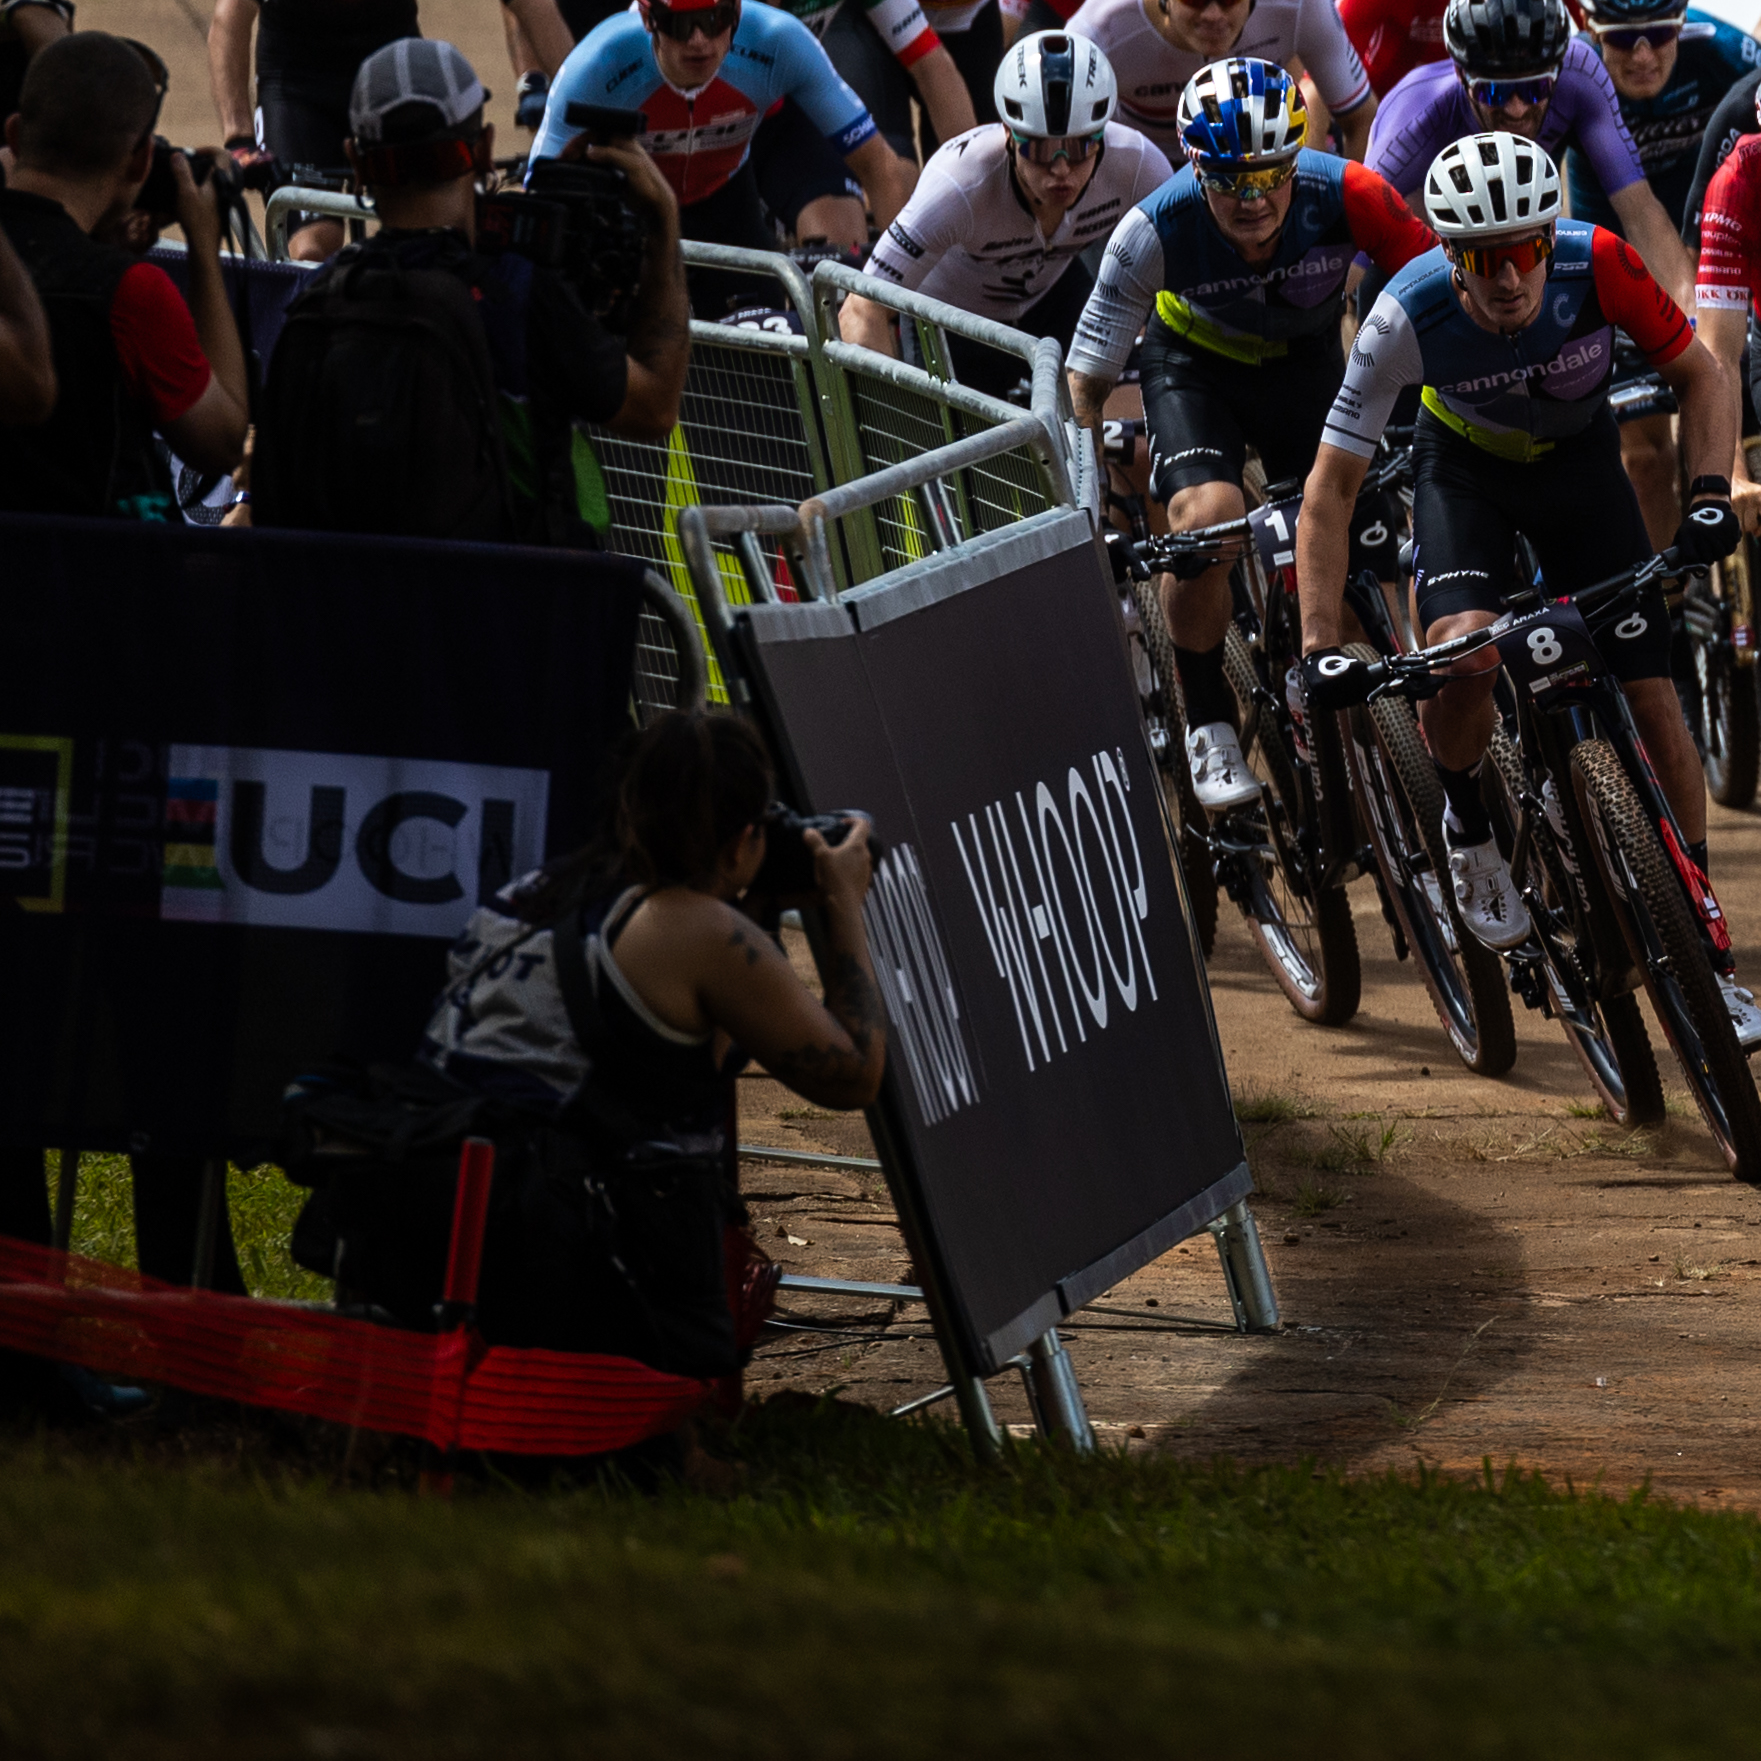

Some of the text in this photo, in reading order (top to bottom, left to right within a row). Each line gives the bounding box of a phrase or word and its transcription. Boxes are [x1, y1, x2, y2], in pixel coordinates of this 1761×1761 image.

[1438, 343, 1604, 393] cannondale
[1427, 569, 1490, 587] S-PHYRE
[1526, 626, 1563, 666] 8
[229, 784, 517, 905] UCI
[951, 747, 1158, 1072] WHOOP
